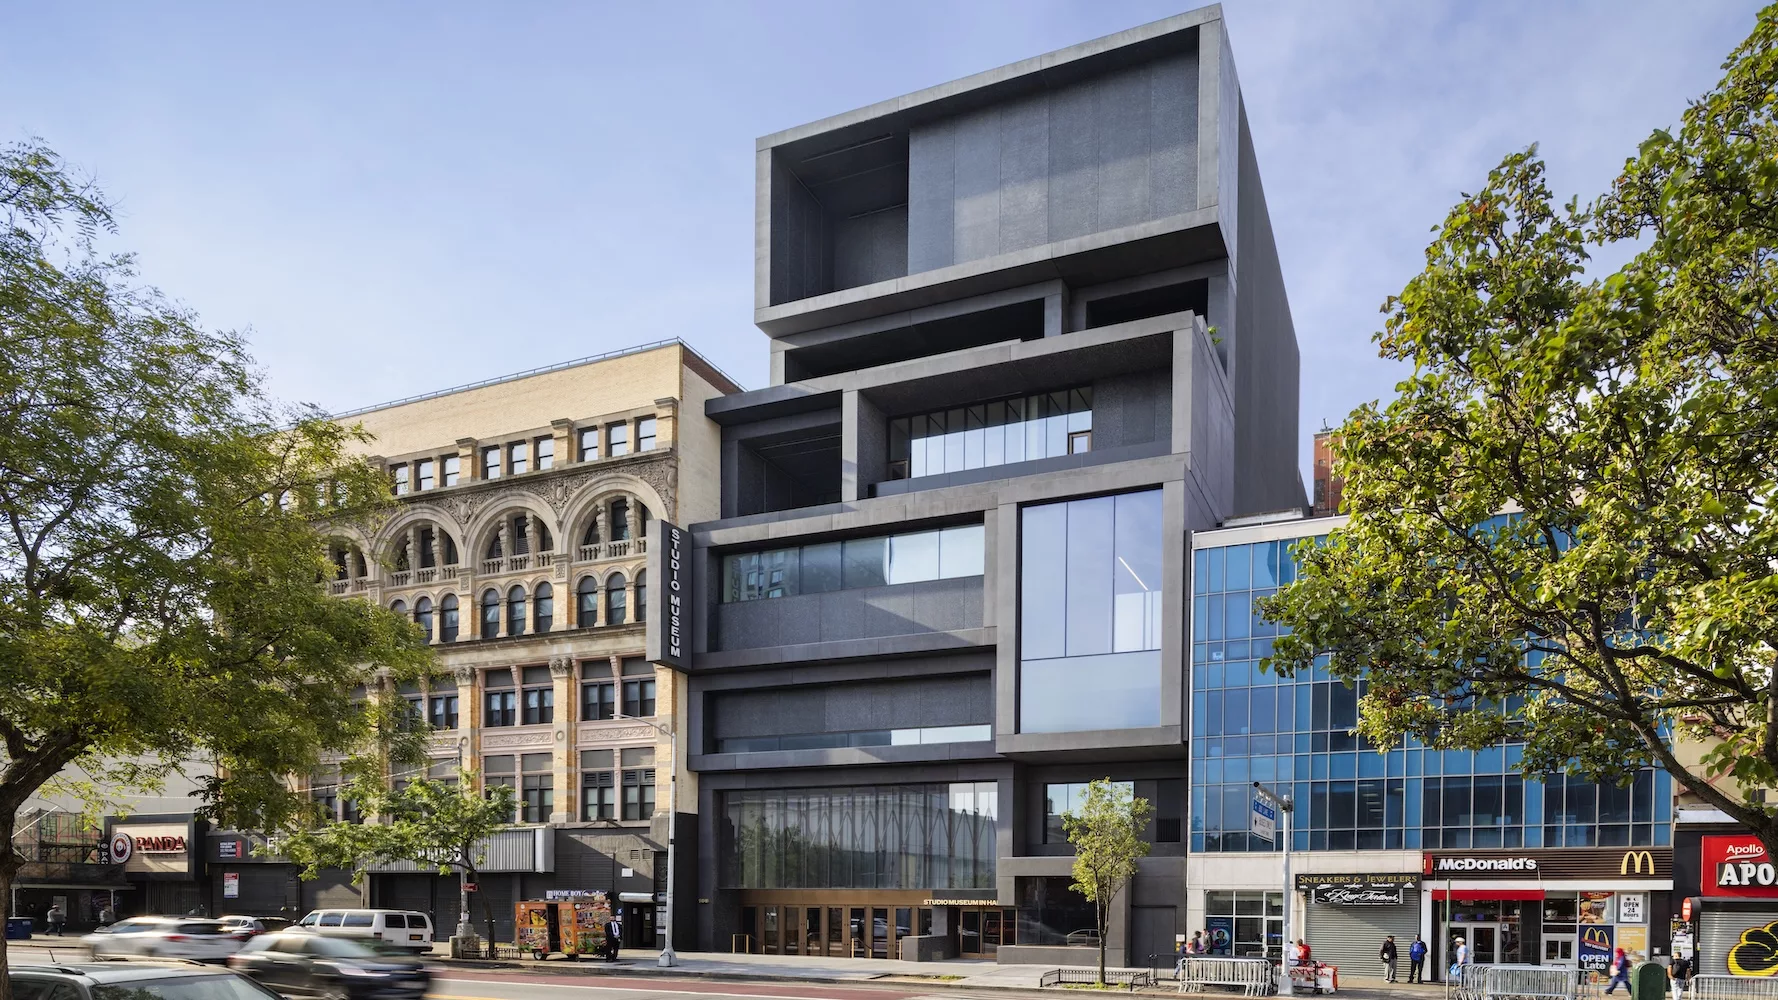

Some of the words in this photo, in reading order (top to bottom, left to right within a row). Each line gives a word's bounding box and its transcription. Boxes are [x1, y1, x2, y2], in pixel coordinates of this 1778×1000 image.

[671, 528, 680, 591] STUDIO
[670, 594, 680, 657] MUSEUM
[135, 836, 186, 851] PANDA
[1726, 844, 1764, 855] Apollo
[1438, 858, 1537, 870] McDonald's
[1299, 875, 1351, 884] SNEAKERS
[1365, 874, 1417, 883] JEWELERS
[1718, 862, 1778, 886] APO
[1580, 954, 1609, 963] OPEN
[1584, 961, 1606, 970] Late
